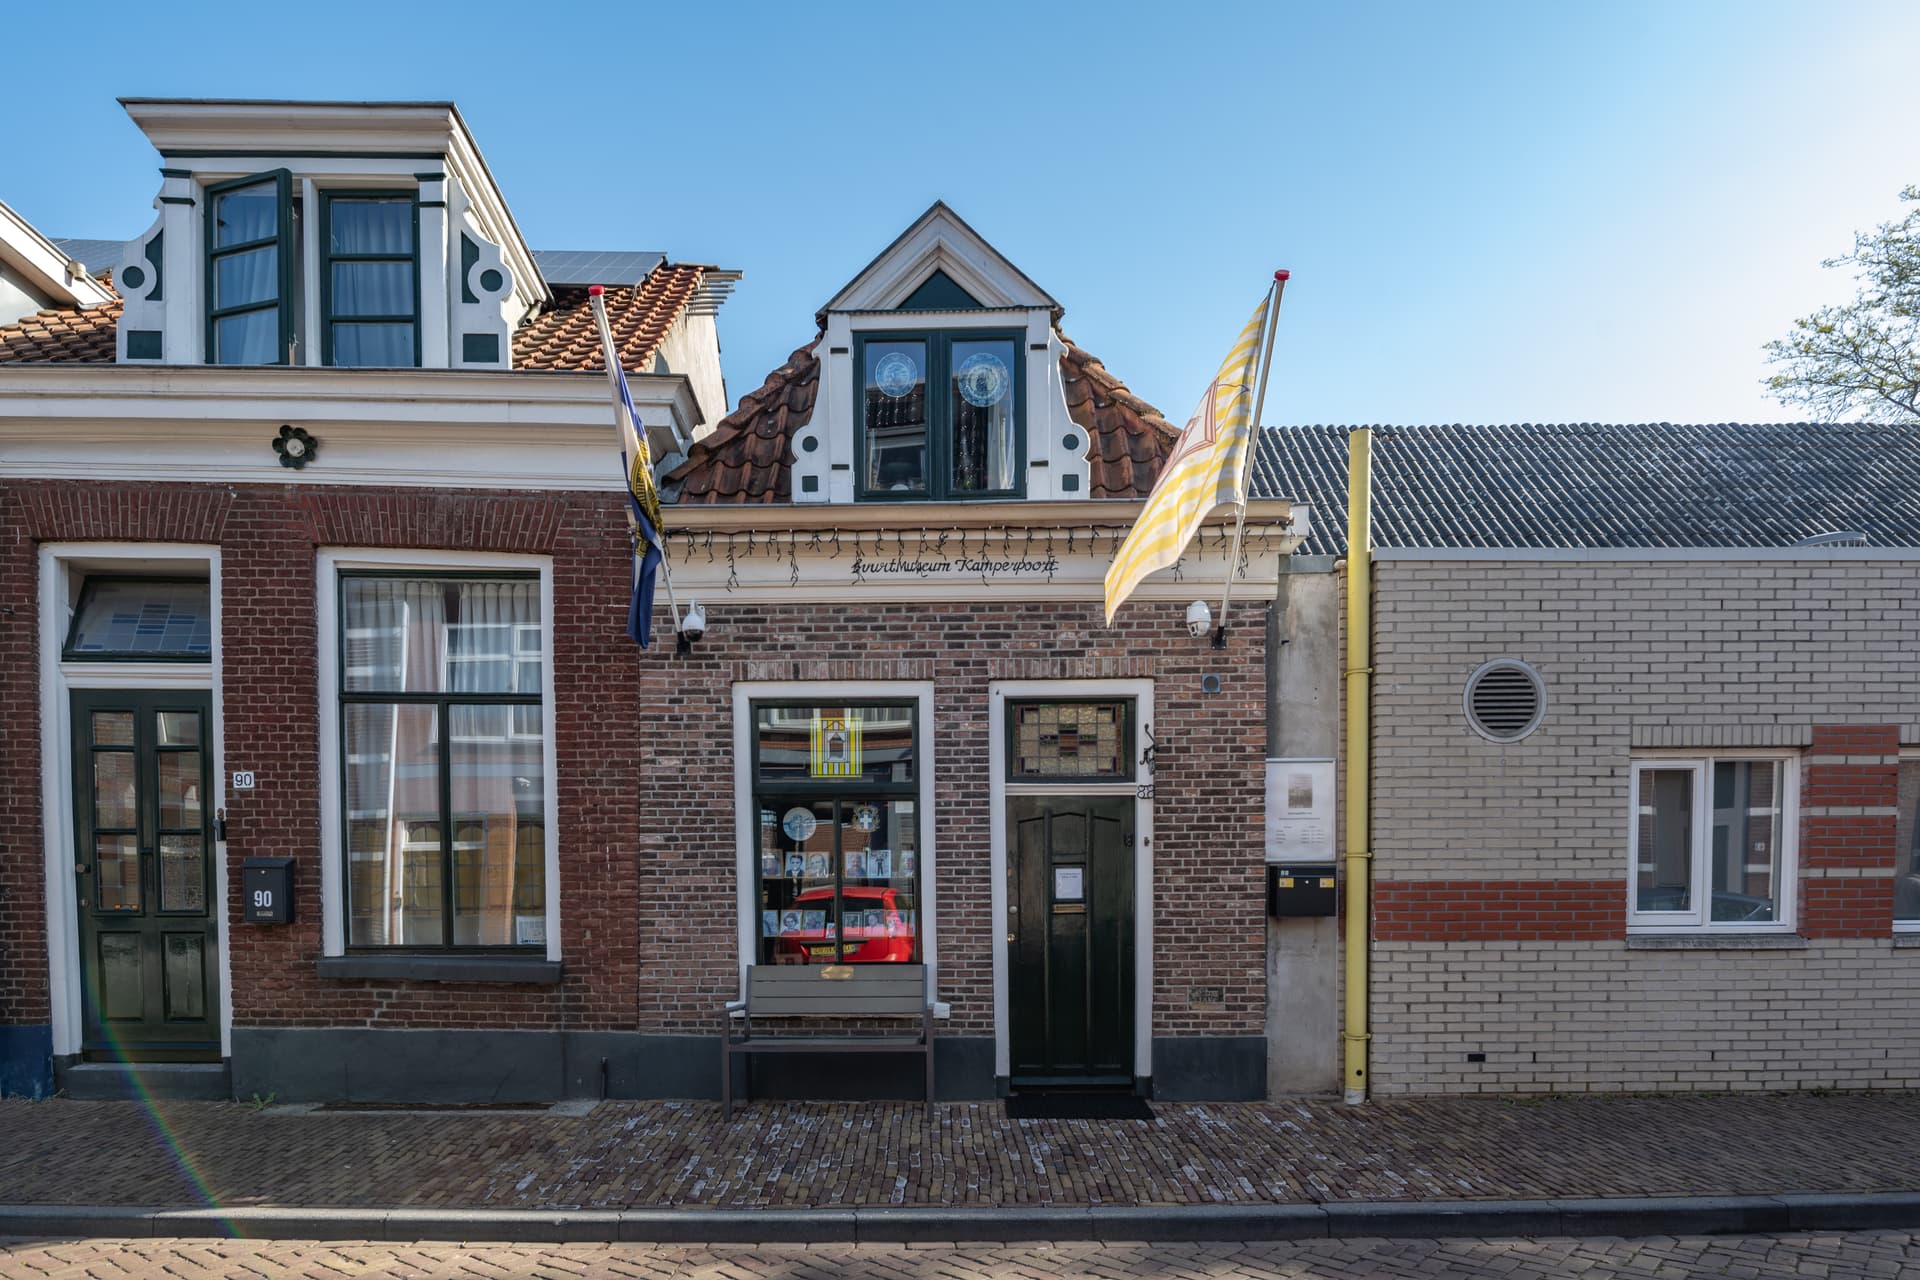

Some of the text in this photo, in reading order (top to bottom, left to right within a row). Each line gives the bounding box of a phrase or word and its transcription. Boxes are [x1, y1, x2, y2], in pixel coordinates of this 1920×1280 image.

[954, 559, 1059, 577] Kamperpoort
[235, 774, 252, 786] 90
[1137, 784, 1155, 799] 88
[254, 890, 272, 907] 90
